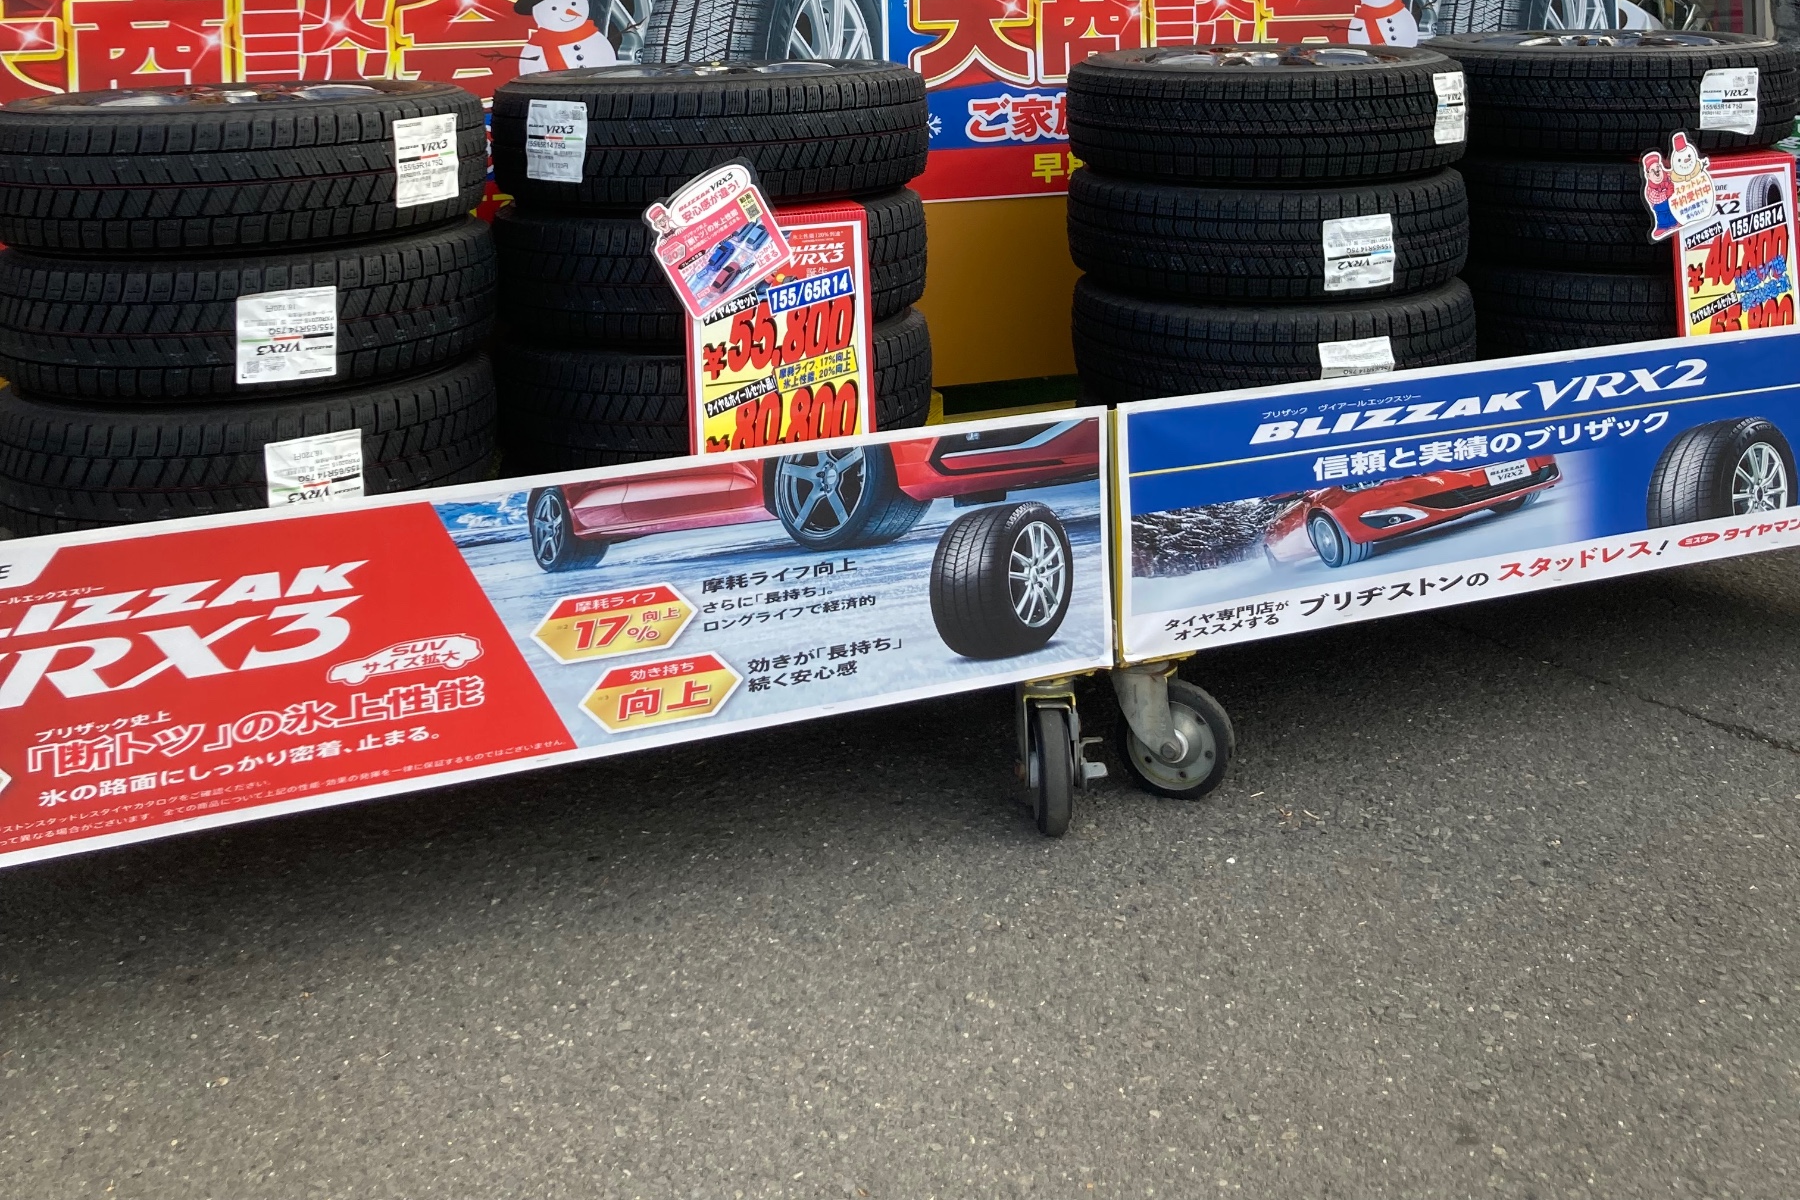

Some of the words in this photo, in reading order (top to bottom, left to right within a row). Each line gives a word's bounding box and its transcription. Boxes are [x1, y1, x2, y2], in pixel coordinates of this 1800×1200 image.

[1723, 88, 1749, 98] VRX2
[546, 125, 575, 135] VRX3
[421, 138, 449, 154] VRX3
[399, 161, 431, 172] 155/65R14
[678, 189, 711, 213] BLIZZAK
[710, 171, 734, 192] VRX3
[681, 179, 741, 223] 安心感が違う!
[1671, 184, 1712, 210] 予約受付中
[1731, 205, 1784, 238] 155/65R14
[756, 250, 779, 269] 止まる
[789, 248, 845, 269] VRX3
[1337, 257, 1371, 271] VRX2
[771, 272, 849, 310] 155/65R14
[268, 327, 286, 336] 75Q
[287, 323, 335, 334] 155/65R14
[703, 295, 855, 380] ¥55,800
[256, 341, 302, 356] VRX3
[1249, 389, 1531, 445] BLIZZAK
[1533, 358, 1708, 411] VRX2
[1262, 406, 1308, 419] ブリザック
[1318, 394, 1422, 412] ヴィアールエックスツー
[1312, 410, 1670, 482] 信頼と実績のブリザック
[297, 473, 316, 483] 75Q
[317, 464, 361, 479] 155/65R14
[1489, 463, 1526, 477] BLIZZAK
[1497, 469, 1525, 482] VRX2
[287, 485, 330, 504] VRX3
[1684, 536, 1716, 546] ミスター
[701, 557, 858, 595] 摩耗ライフ向上
[1299, 571, 1490, 616] ブリヂストンの
[1498, 539, 1670, 580] スタッドレス!
[0, 560, 370, 639] IZZAK
[574, 591, 657, 612] 摩耗ライフ
[703, 586, 833, 614] さらに「長持ち」。
[642, 607, 680, 622] 向上
[703, 595, 876, 633] ロングライフで経済的
[1164, 600, 1290, 631] タイヤ専門店が
[573, 615, 660, 651] 17%
[1173, 614, 1280, 642] オススメする
[388, 638, 448, 658] SUV
[747, 637, 903, 675] 効きが「長持ち」
[361, 648, 461, 675] サイズ拡大
[629, 661, 695, 682] 効き持ち
[748, 660, 858, 693] 続く安心感
[616, 679, 712, 722] 向上
[27, 675, 487, 777] 「断トツ」の氷上性能
[35, 709, 172, 742] ブリザック史上
[38, 725, 442, 809] 氷の路面にしっかり密着、止まる。
